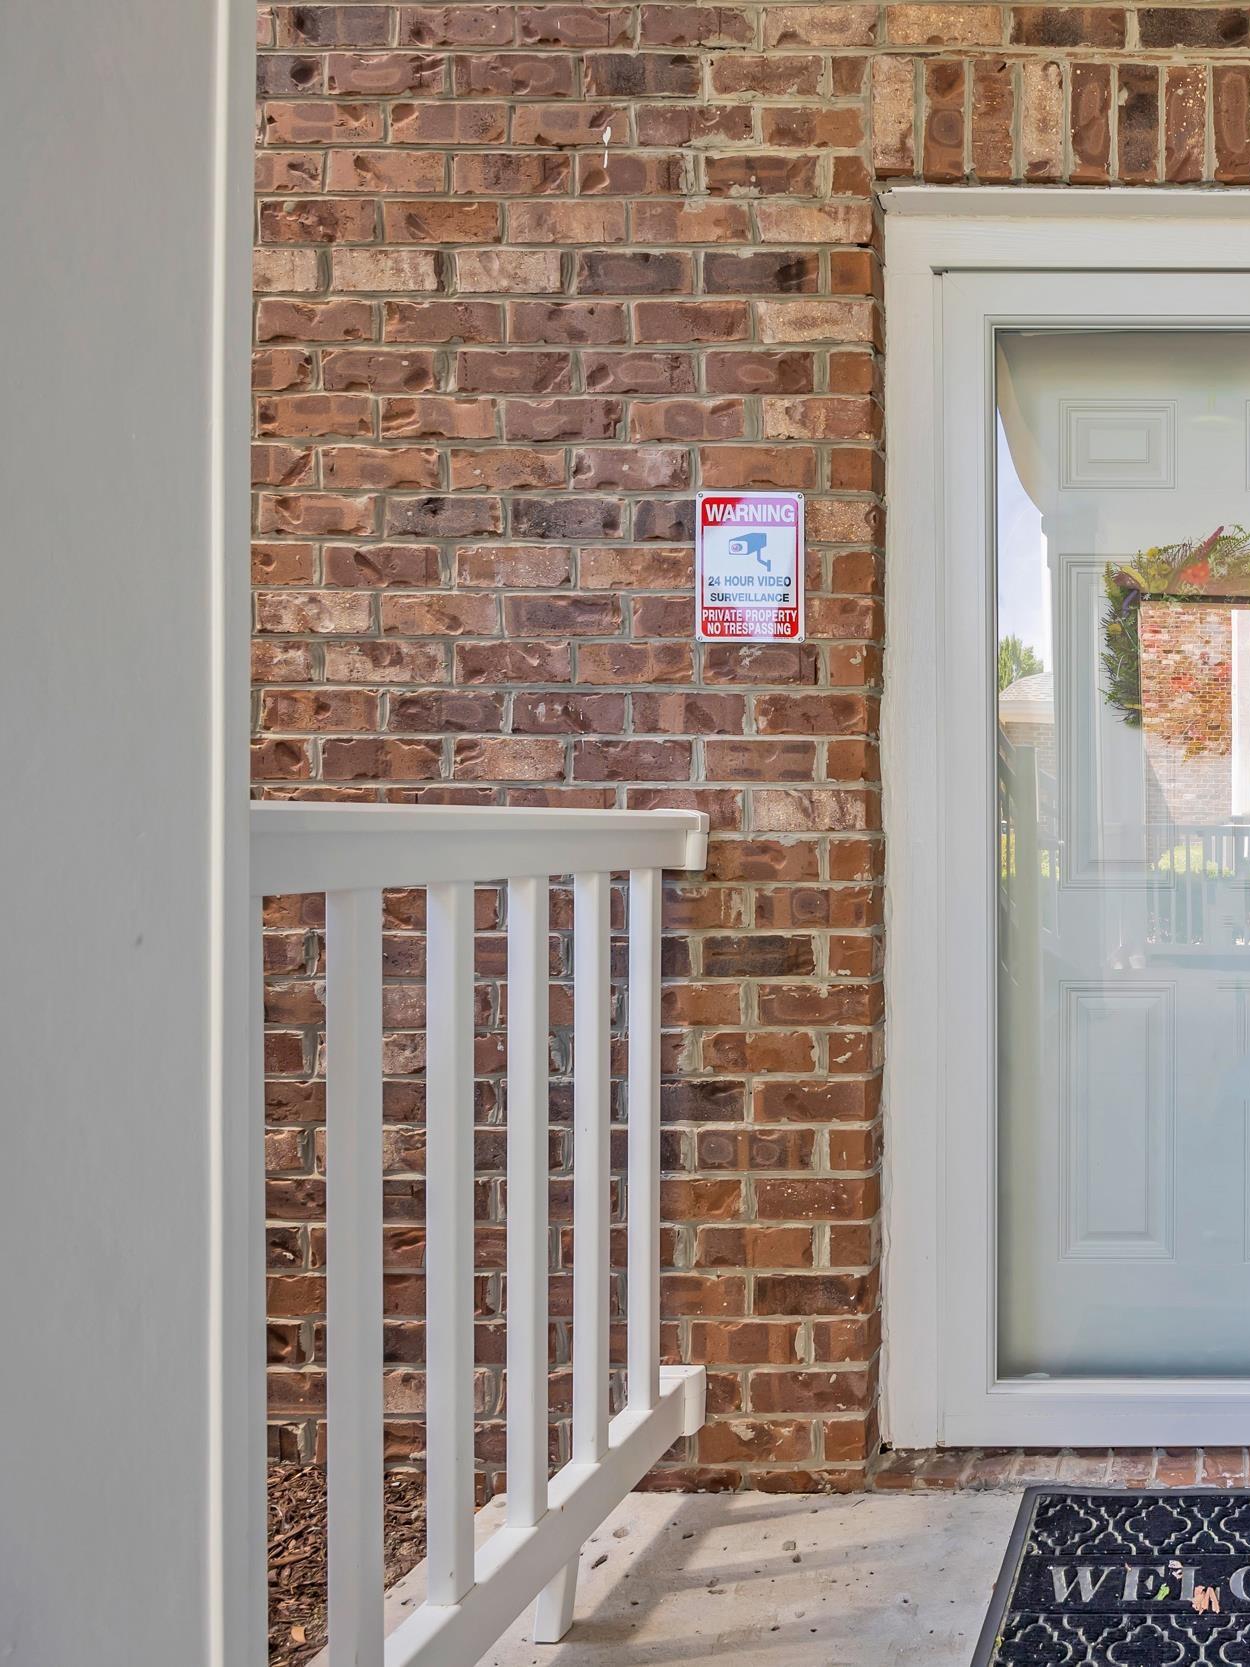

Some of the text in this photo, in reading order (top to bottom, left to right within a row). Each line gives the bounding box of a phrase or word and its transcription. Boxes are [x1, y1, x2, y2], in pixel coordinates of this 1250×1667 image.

[705, 503, 795, 523] WARNING
[708, 575, 792, 587] 24 HOUR VIDEO
[710, 592, 790, 603] SURVEILLANCE
[702, 609, 798, 622] PRIVATE PROPERTY
[707, 622, 792, 636] NO TRESPASSING
